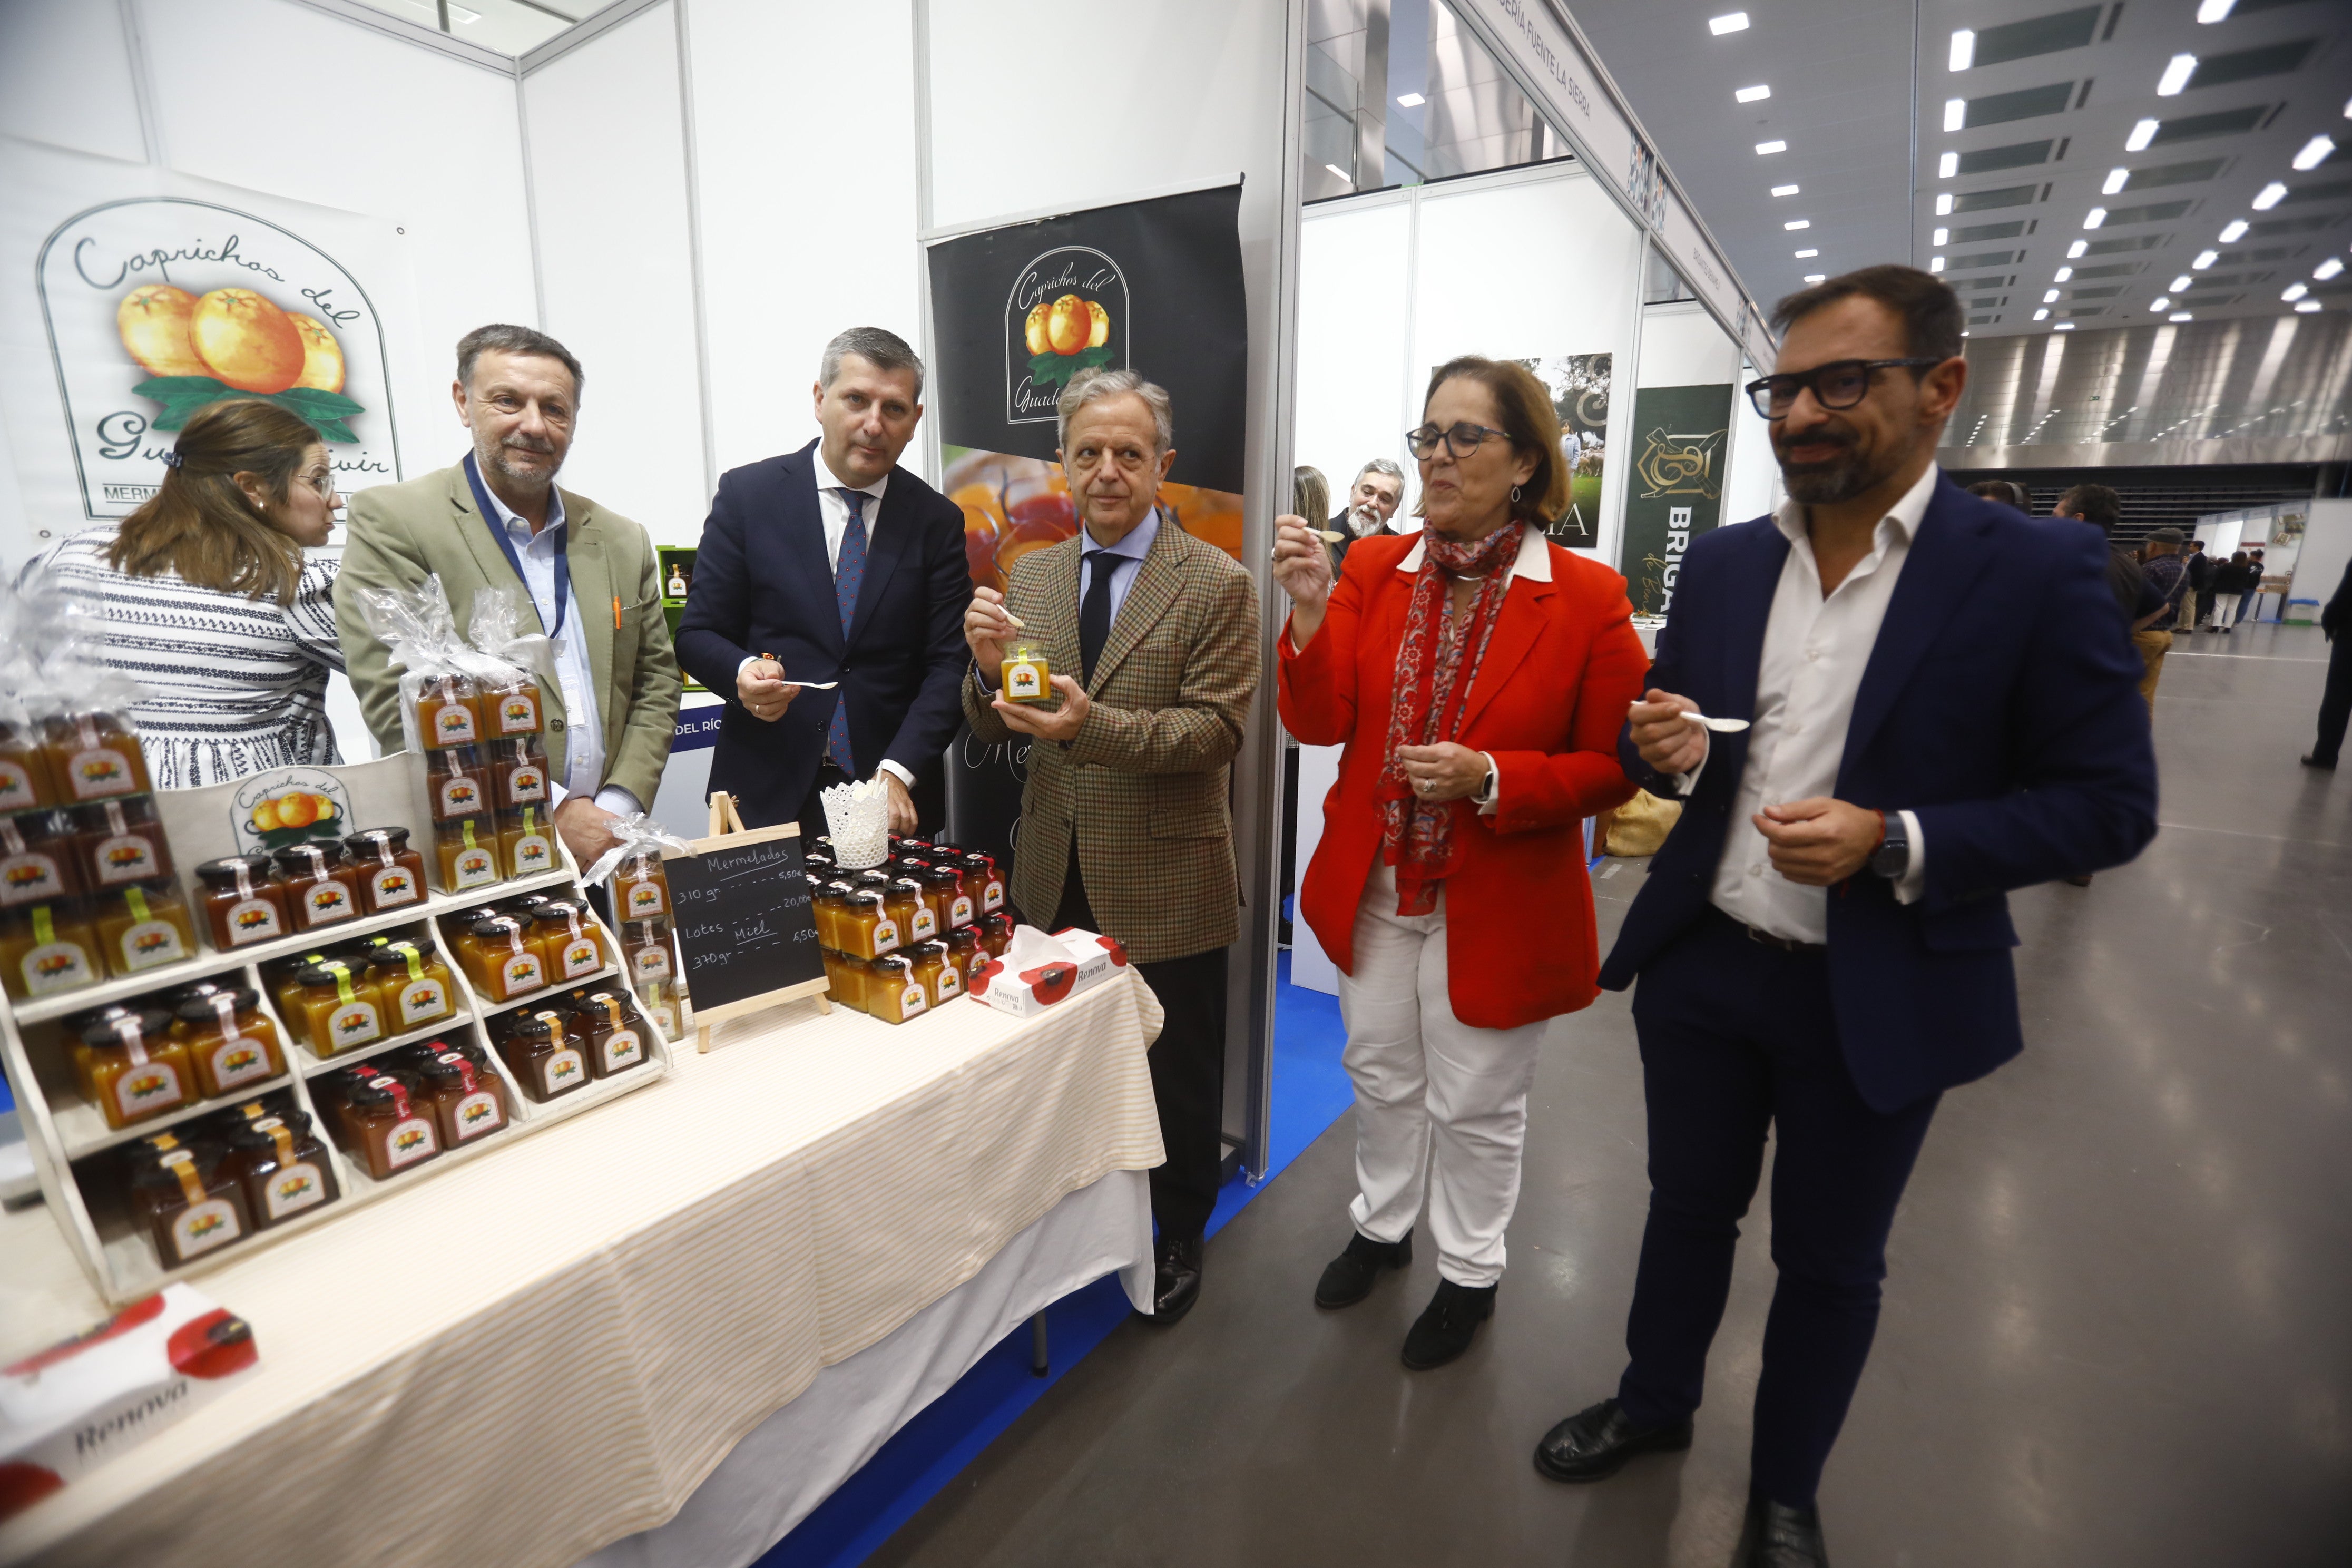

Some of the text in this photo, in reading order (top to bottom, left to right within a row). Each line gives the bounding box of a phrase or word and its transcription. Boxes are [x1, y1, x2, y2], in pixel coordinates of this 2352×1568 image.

[1527, 19, 1555, 75] FUENTE
[1556, 62, 1566, 90] LA
[1568, 77, 1590, 121] SIERRA
[74, 235, 360, 329] Caprichos del
[1018, 262, 1115, 310] Caprichos del
[104, 487, 161, 500] MERM
[675, 723, 700, 736] DEL
[239, 775, 339, 809] Caprichos del
[678, 889, 701, 904] 310
[685, 923, 723, 939] Lotes
[734, 920, 770, 940] Miel
[1078, 962, 1106, 983] Renova
[994, 988, 1019, 1003] Renova
[463, 1073, 476, 1092] Pomelo
[397, 1099, 409, 1118] Pomelo
[75, 1380, 188, 1458] Renova
